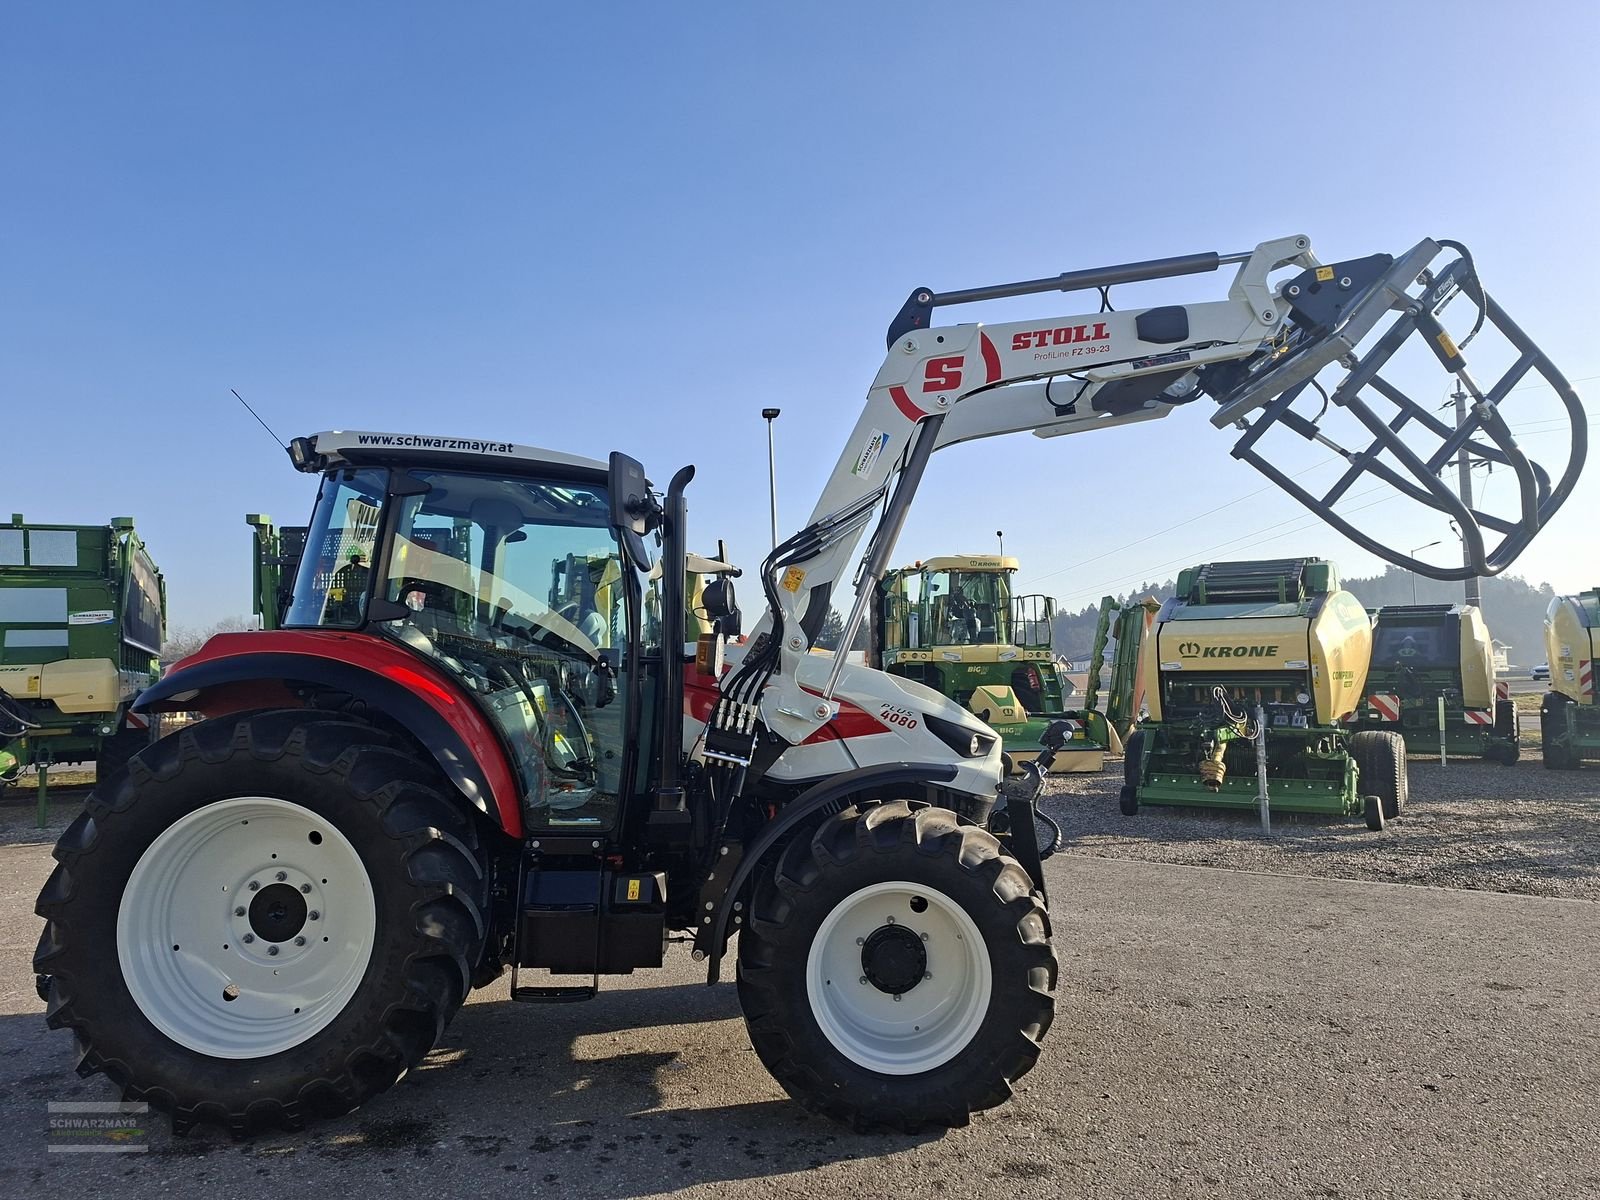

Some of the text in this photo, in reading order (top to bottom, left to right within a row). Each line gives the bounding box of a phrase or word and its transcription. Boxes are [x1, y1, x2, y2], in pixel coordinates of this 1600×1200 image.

[1012, 322, 1110, 351] STOLL
[1033, 344, 1110, 361] ProfiLine FZ 39-23
[922, 355, 964, 393] S
[358, 434, 514, 453] www.schwarzmayr.at
[857, 436, 878, 472] SCHWARZMAYR
[1202, 645, 1279, 658] KRONE
[880, 710, 918, 729] 4080
[881, 703, 914, 717] PLUS
